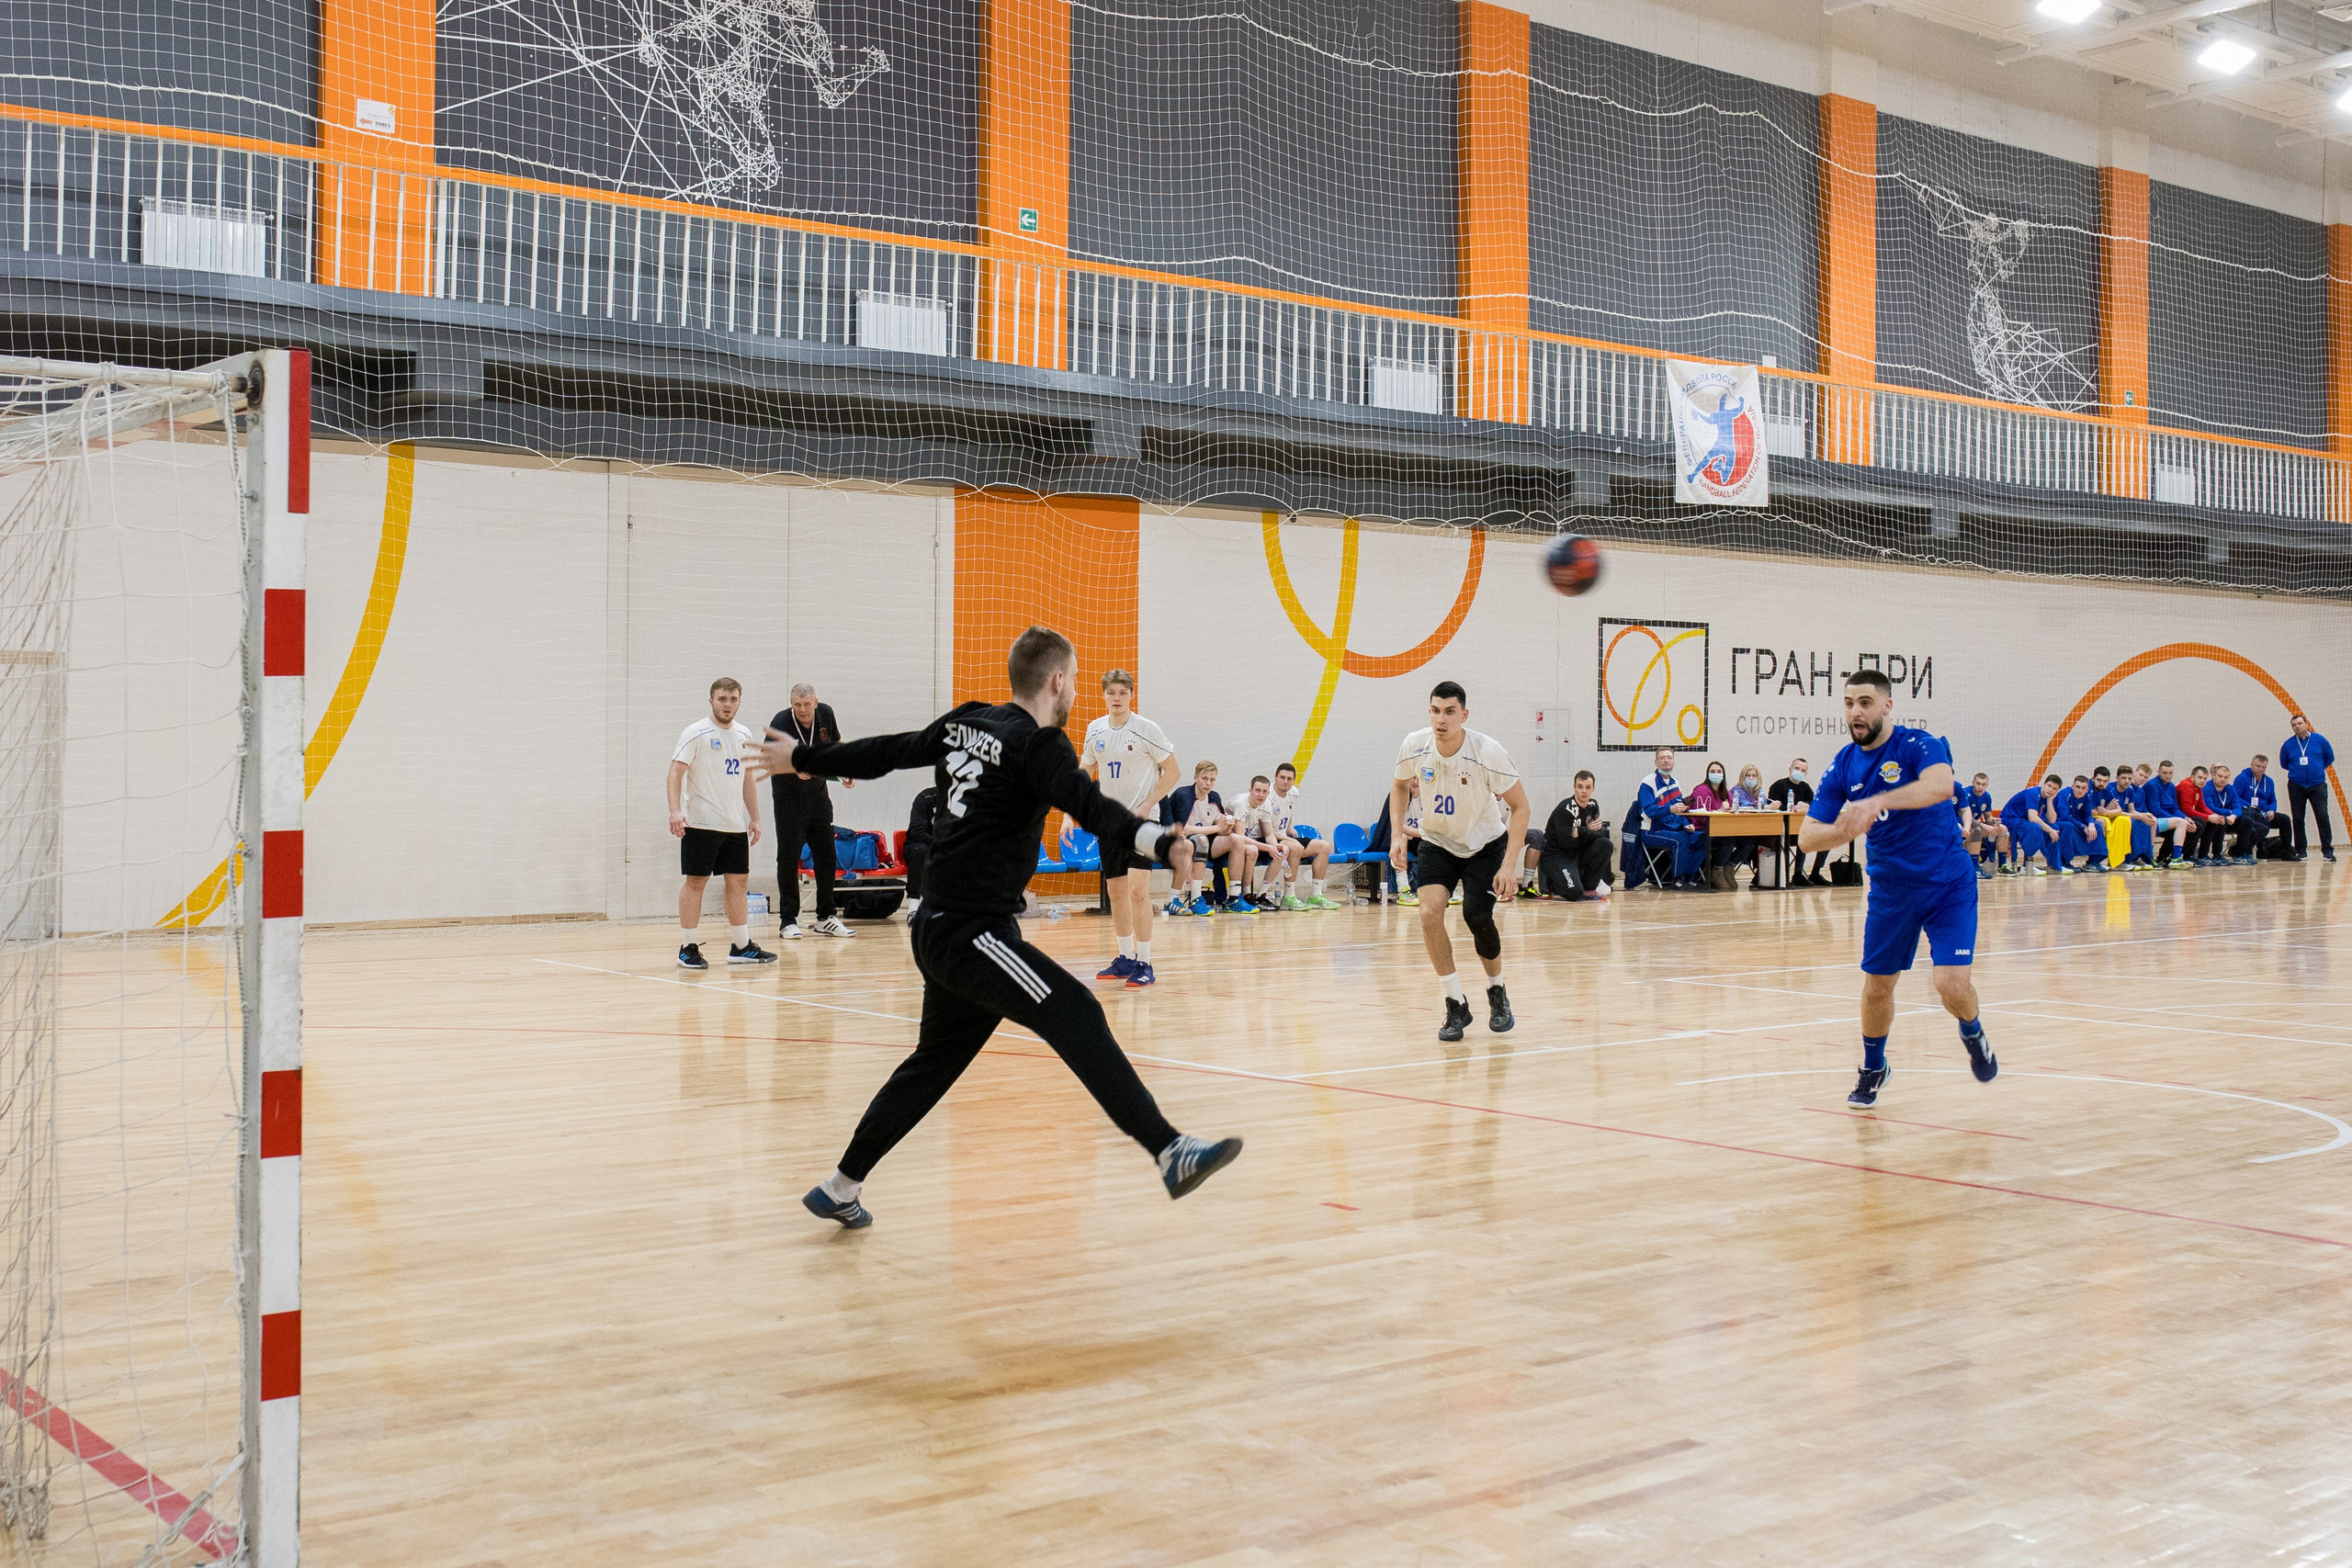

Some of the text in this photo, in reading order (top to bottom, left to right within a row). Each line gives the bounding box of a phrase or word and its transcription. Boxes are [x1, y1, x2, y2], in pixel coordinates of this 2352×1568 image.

[1699, 478, 1731, 498] HANDBALL
[1732, 457, 1760, 497] FEDERATION
[1736, 715, 1850, 735] СПОРТИВНЫ
[725, 759, 740, 774] 22
[1107, 761, 1121, 778] 17
[1434, 795, 1454, 815] 20
[1279, 818, 1288, 829] 27
[1407, 818, 1419, 829] 25
